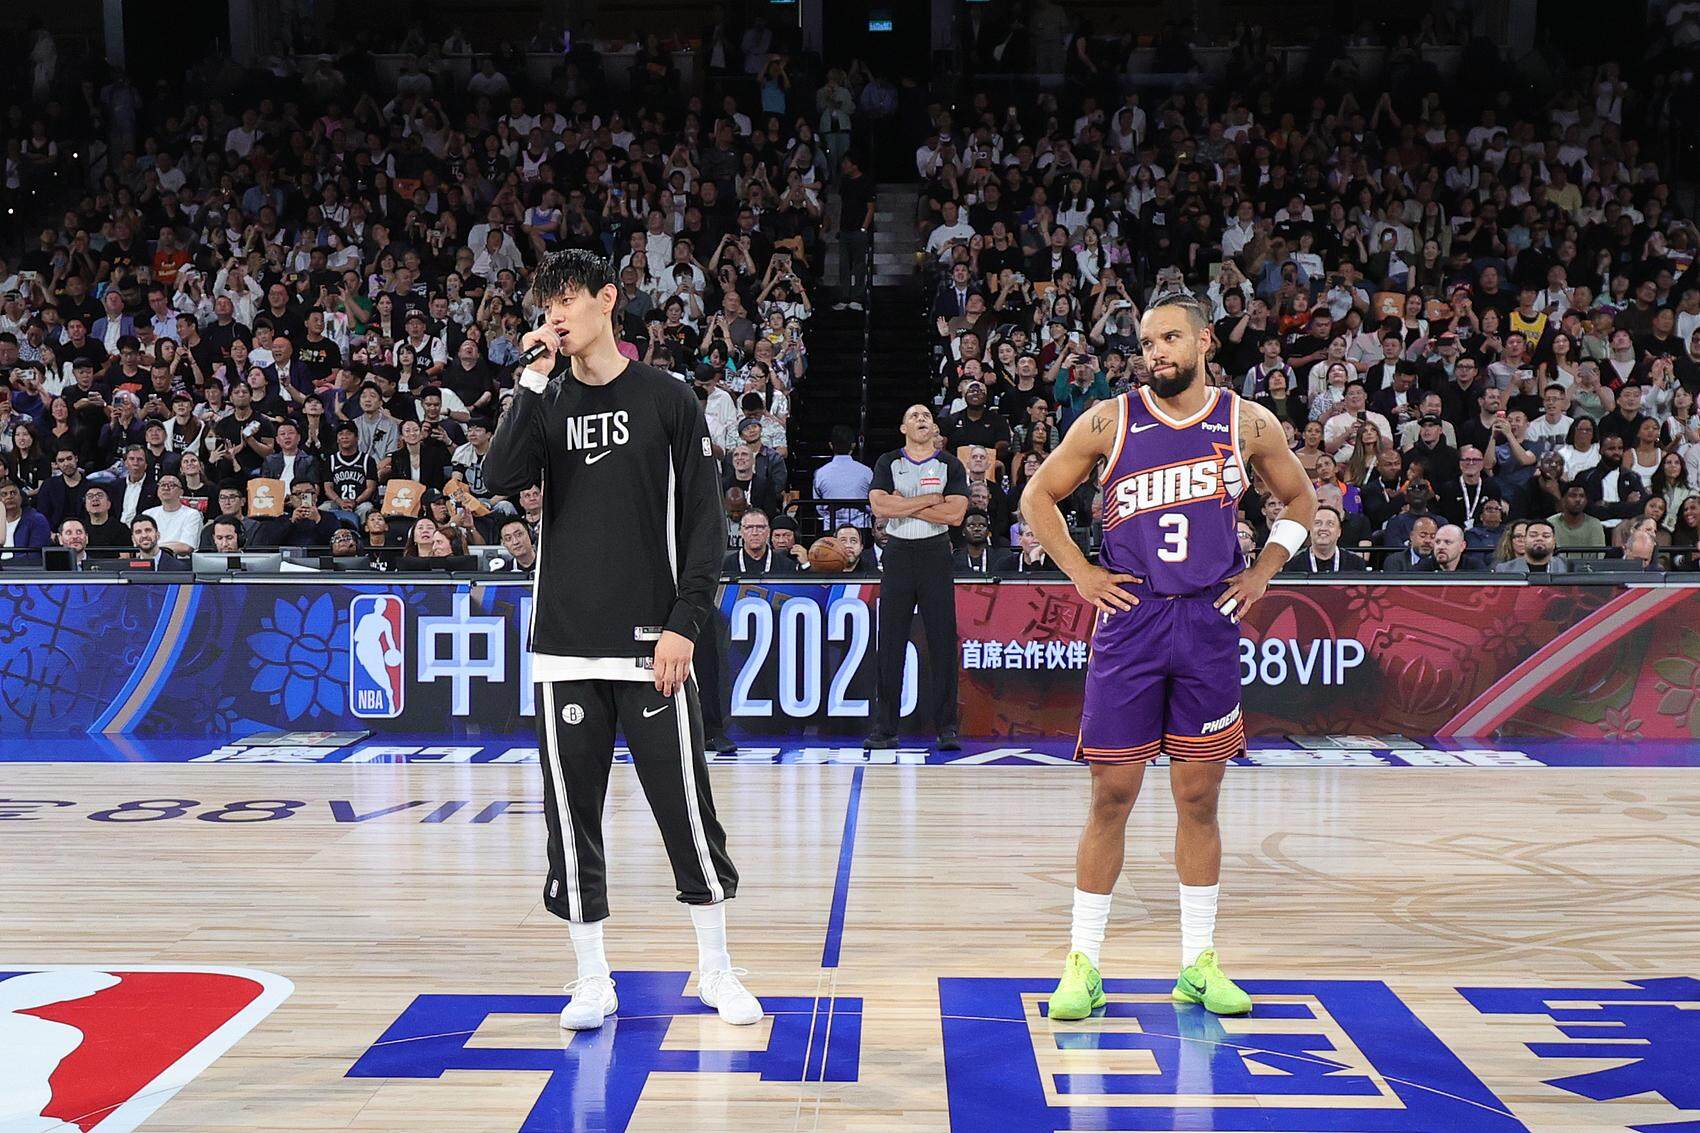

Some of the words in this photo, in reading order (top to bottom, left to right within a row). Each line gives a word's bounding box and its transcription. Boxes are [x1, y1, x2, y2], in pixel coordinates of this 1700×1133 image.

[566, 410, 630, 450] NETS
[1201, 422, 1229, 432] PayPal
[341, 484, 356, 500] 25
[1116, 460, 1218, 518] SUNS
[1157, 513, 1190, 563] 3
[962, 639, 1087, 670] 首席合作伙伴
[1239, 638, 1365, 686] 88VIP
[358, 690, 383, 710] NBA
[1201, 702, 1240, 734] PHOEN
